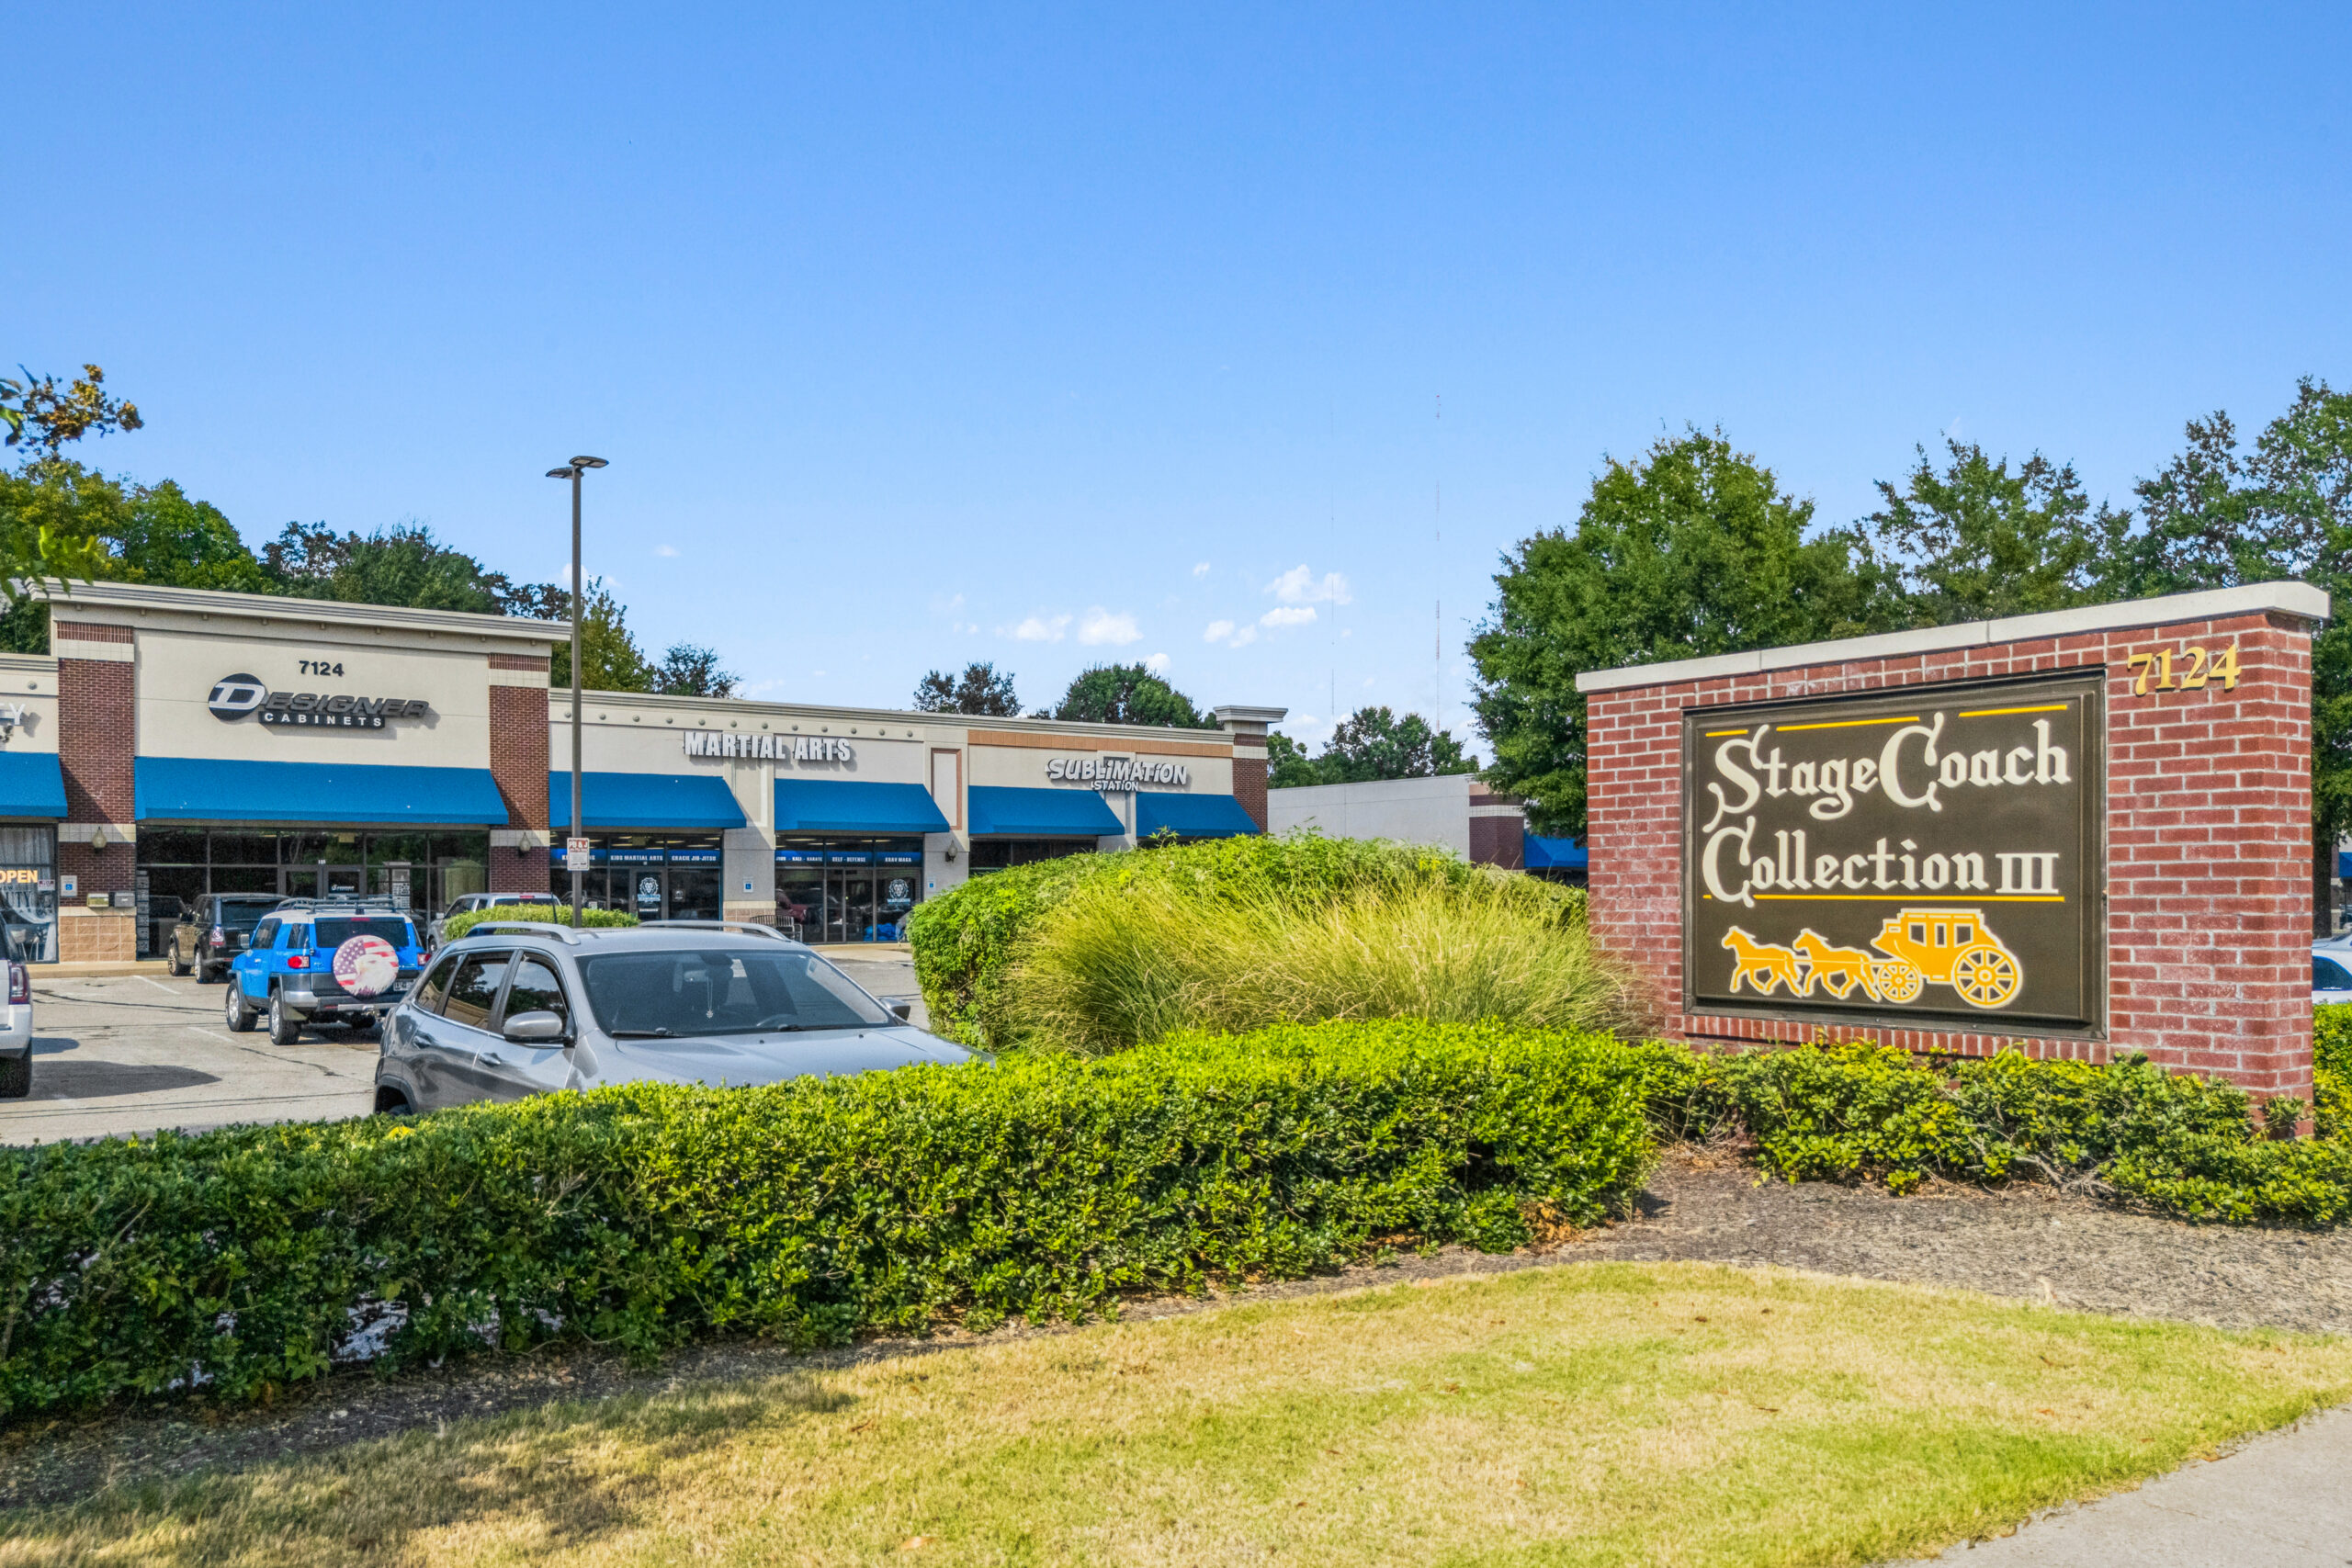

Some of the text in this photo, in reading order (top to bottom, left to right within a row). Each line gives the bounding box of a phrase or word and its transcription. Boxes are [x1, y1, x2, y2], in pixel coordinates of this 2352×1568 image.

[299, 660, 345, 677] 7124
[2127, 644, 2242, 697] 7124
[209, 682, 429, 717] DESIGNER
[264, 712, 382, 727] CABINETS
[683, 731, 851, 761] MARTIAL ARTS
[0, 869, 39, 884] OPEN
[1702, 816, 2060, 908] Collection III
